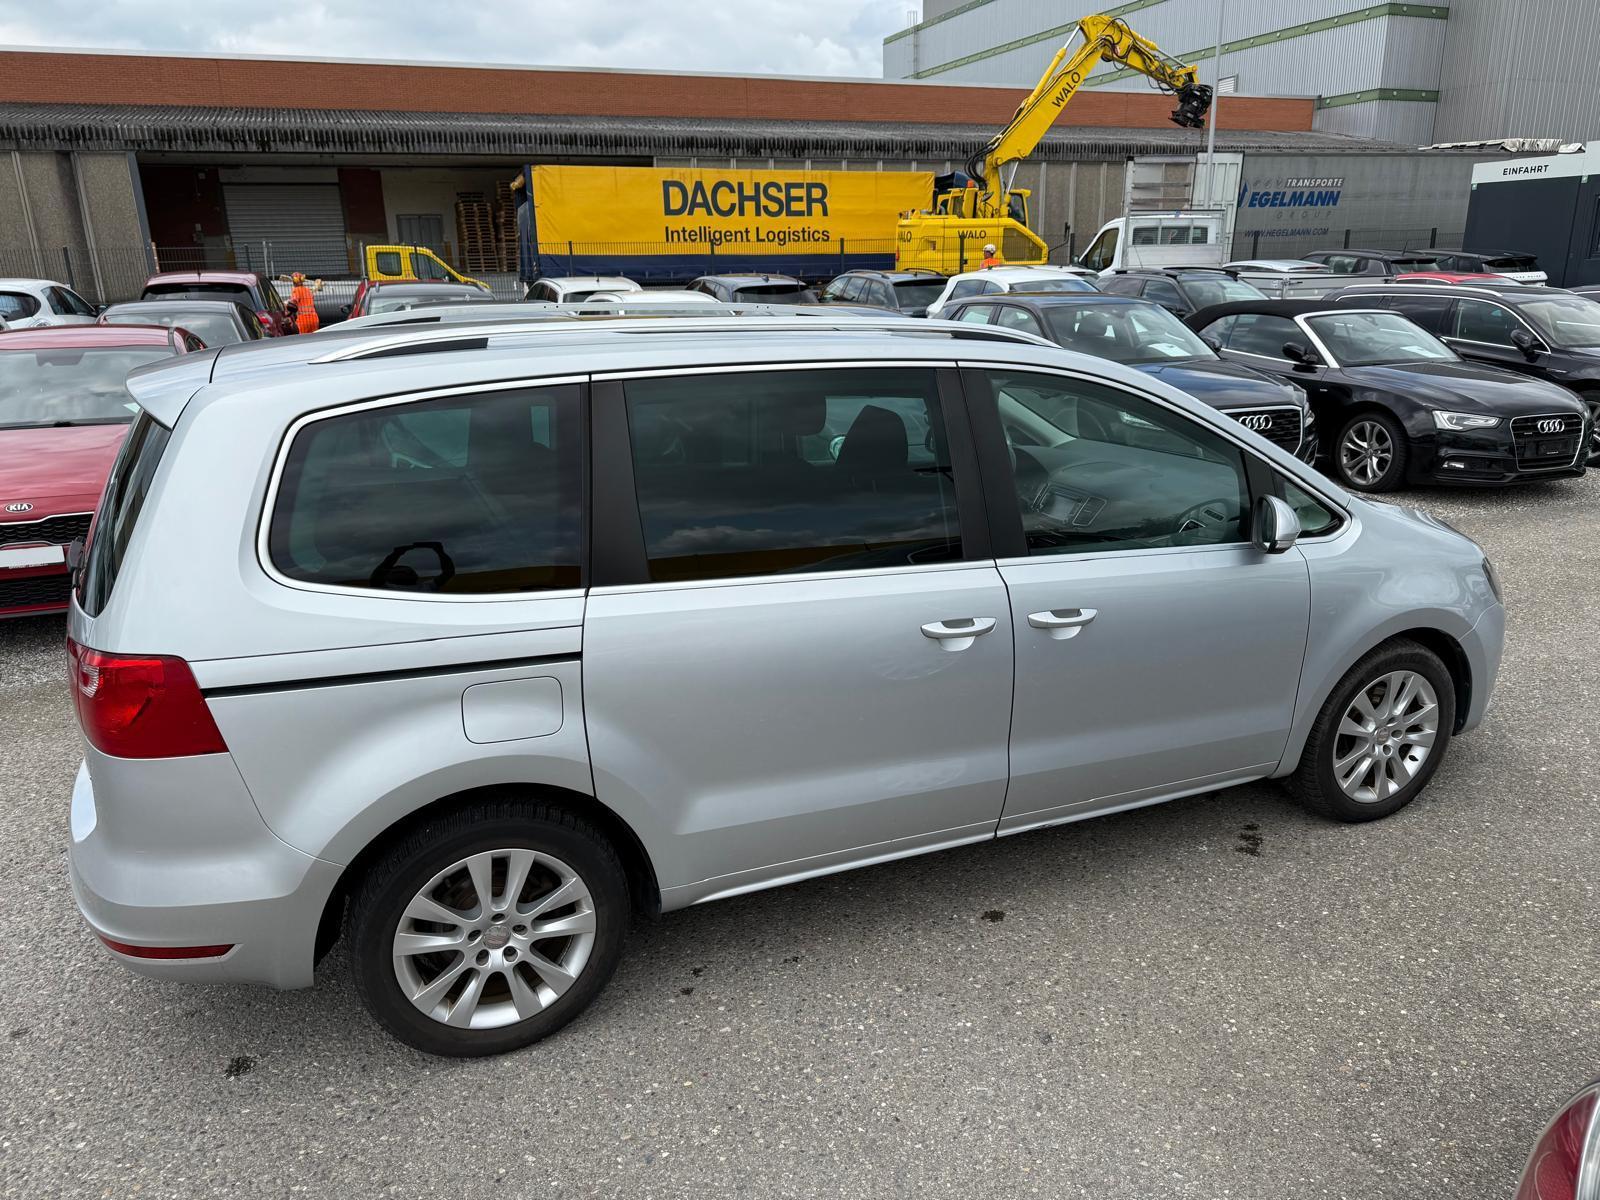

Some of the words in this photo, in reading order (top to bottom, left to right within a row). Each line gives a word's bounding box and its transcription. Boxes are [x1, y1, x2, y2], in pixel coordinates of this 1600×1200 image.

[1052, 71, 1081, 107] WALO
[1503, 165, 1549, 176] EINFAHRT
[1286, 178, 1343, 187] TRANSPORTE
[662, 180, 829, 218] DACHSER
[664, 226, 750, 246] Intelligent
[755, 226, 830, 246] Logistics
[957, 229, 987, 239] WALO
[9, 503, 29, 511] KIA
